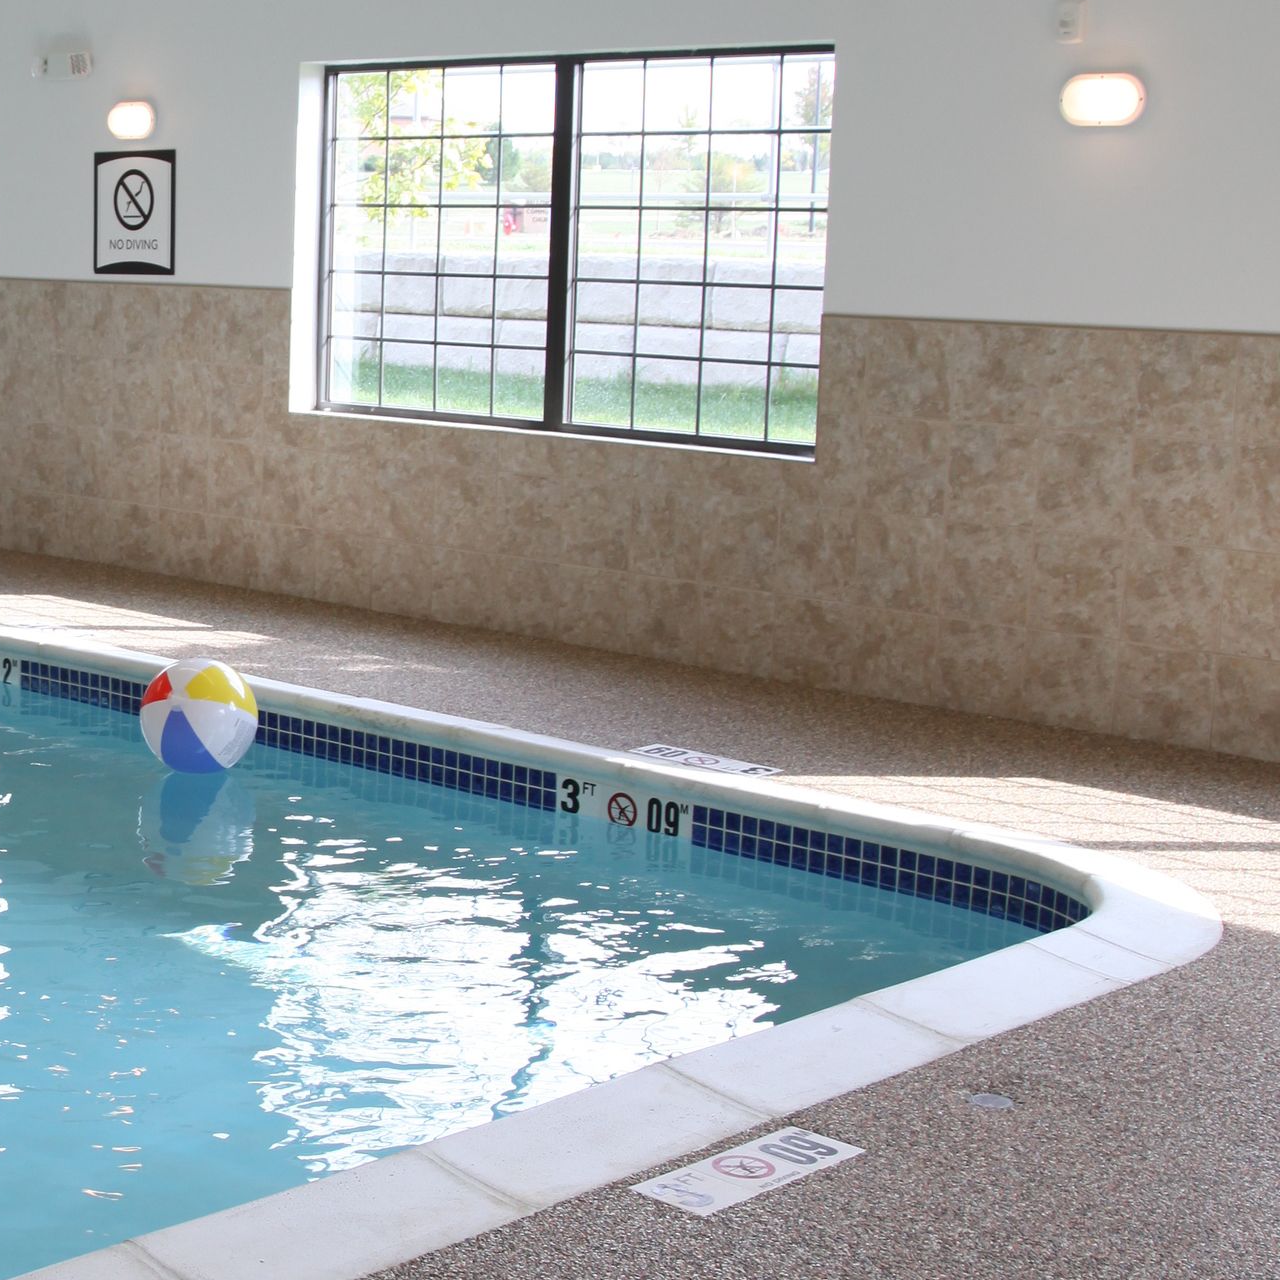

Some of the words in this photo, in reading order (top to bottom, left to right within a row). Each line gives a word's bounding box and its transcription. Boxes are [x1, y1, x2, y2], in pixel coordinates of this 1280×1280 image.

[109, 239, 124, 250] NO
[126, 239, 158, 250] DIVING
[561, 779, 580, 814] 3
[582, 782, 596, 796] FT
[647, 797, 680, 837] 09
[680, 804, 688, 815] M
